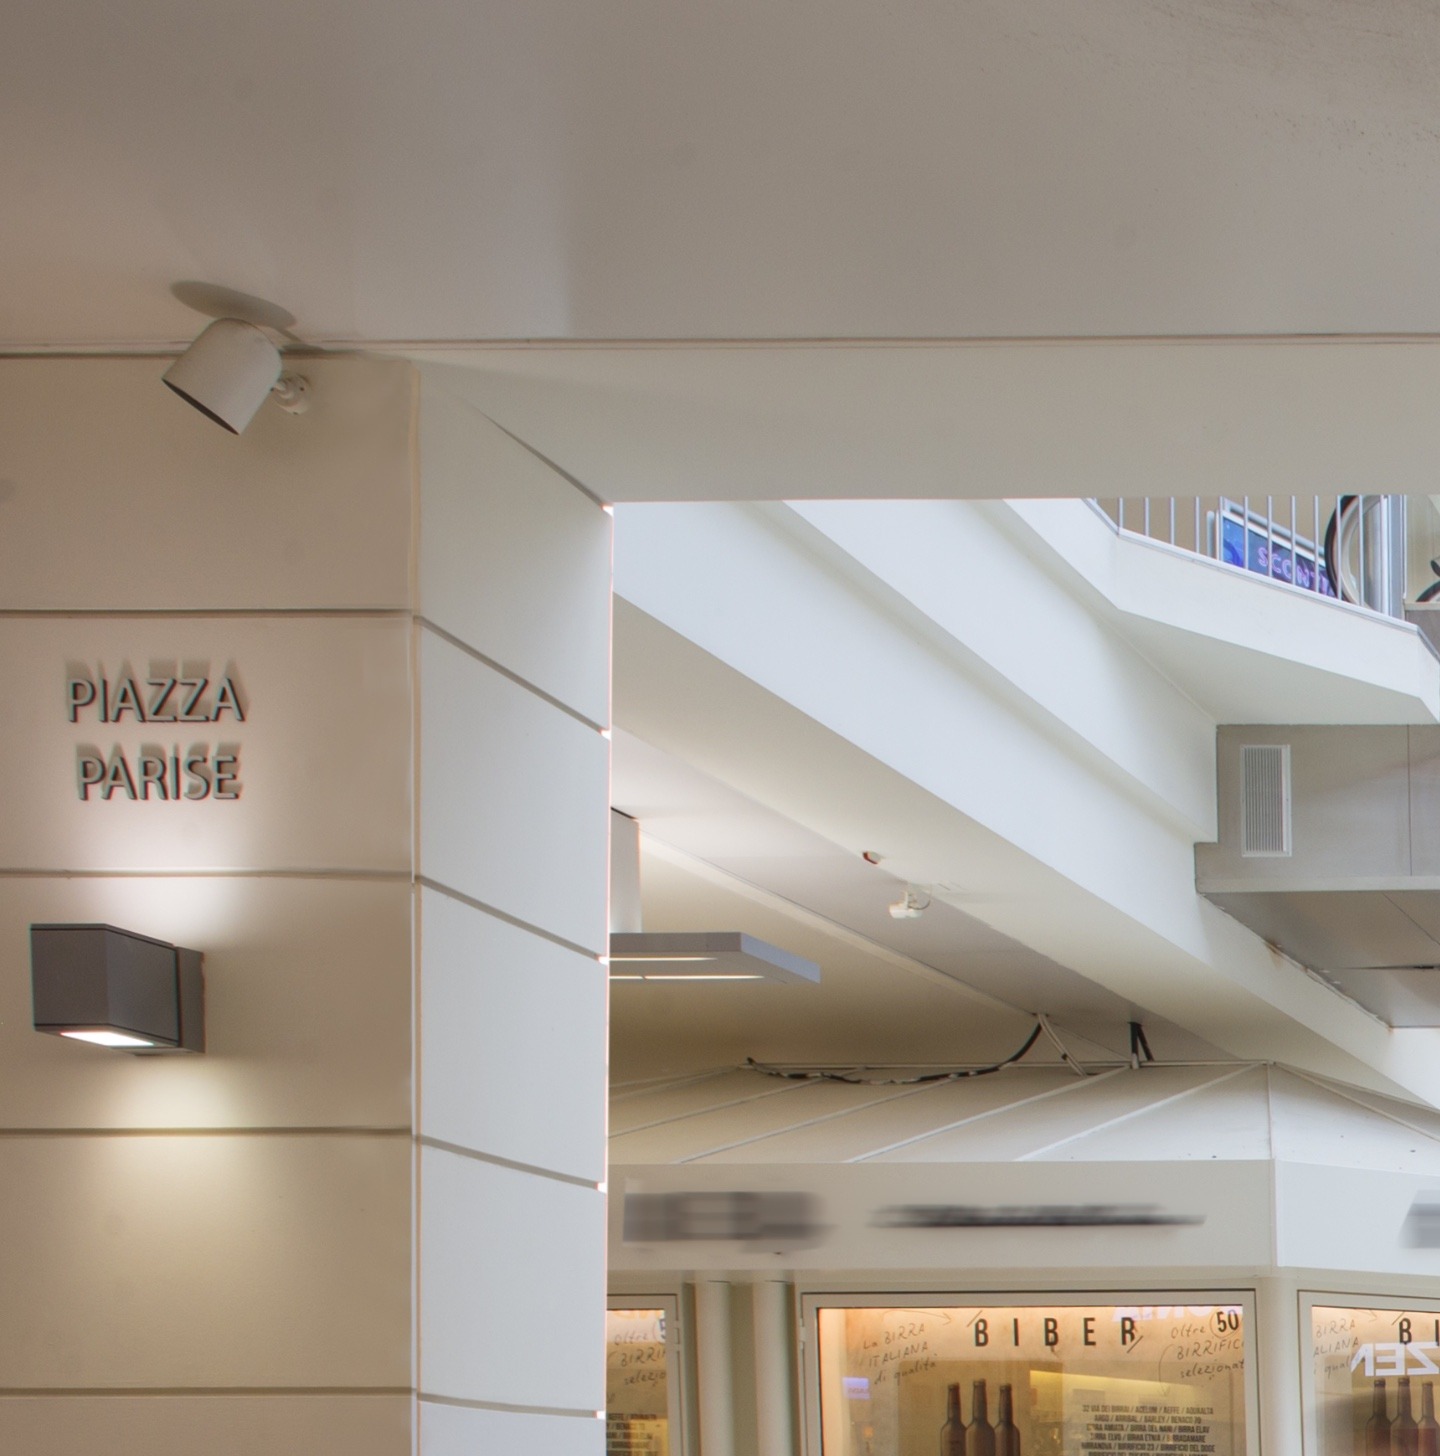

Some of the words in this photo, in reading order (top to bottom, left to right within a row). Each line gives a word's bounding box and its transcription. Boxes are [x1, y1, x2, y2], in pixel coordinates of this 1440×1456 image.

[67, 677, 245, 724] PIAZZA
[78, 755, 242, 801] PARISE
[885, 1323, 925, 1344] BIRRA
[973, 1317, 1136, 1347] BIBER
[1216, 1310, 1240, 1332] 50
[869, 1341, 928, 1368] ITALIANA
